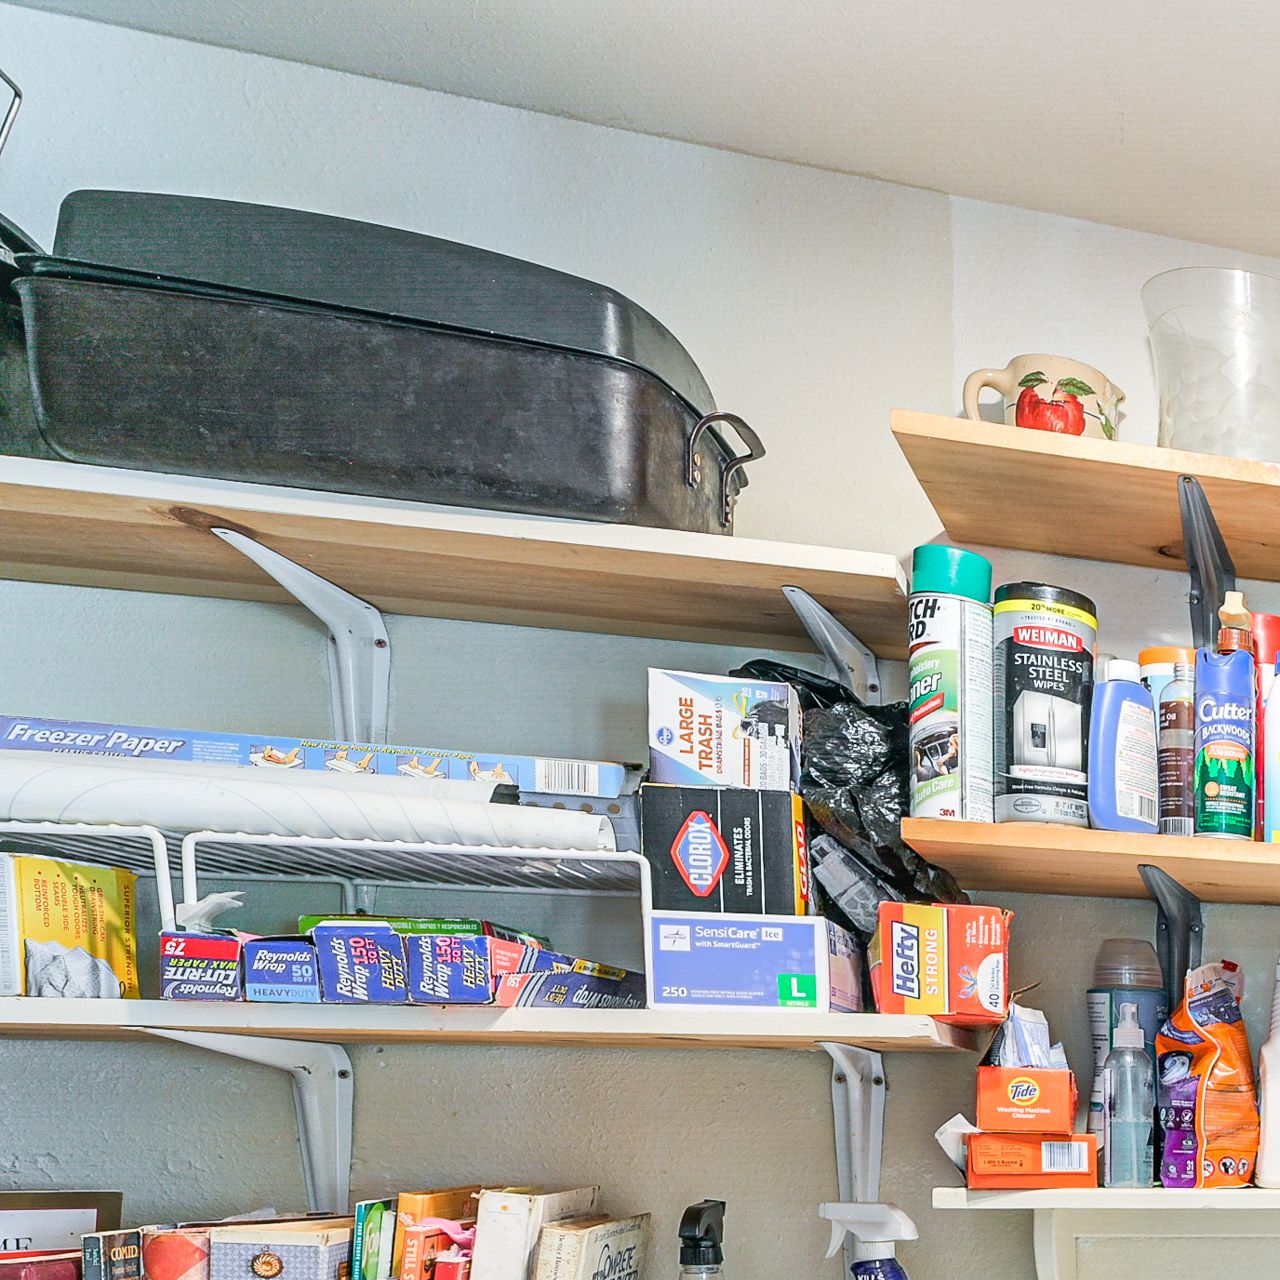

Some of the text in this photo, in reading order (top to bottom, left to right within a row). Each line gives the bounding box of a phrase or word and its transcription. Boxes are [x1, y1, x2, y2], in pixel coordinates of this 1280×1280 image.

[1017, 628, 1077, 649] WEIMAN
[1014, 653, 1083, 673] STAINLESS
[1028, 667, 1070, 683] STEEL
[1033, 680, 1065, 691] WIPES
[678, 697, 695, 755] LARGE
[1200, 699, 1253, 722] Cutter
[7, 723, 108, 748] Freezer
[105, 731, 185, 758] Paper
[698, 713, 714, 771] TRASH
[1202, 723, 1251, 744] BACKWOODS
[939, 808, 955, 817] 3M
[687, 820, 713, 886] CLOROX
[732, 826, 745, 885] ELIMINATES
[795, 824, 808, 896] GLAD
[34, 878, 42, 912] BOTTOM
[41, 879, 50, 928] REINFORCED
[61, 881, 69, 913] DOUBLE
[78, 884, 88, 934] NEUTRALIZES
[90, 886, 99, 935] DRAWSTRING
[72, 885, 82, 939] TOUGH ODORS
[694, 925, 780, 939] SensiCare Ice
[695, 940, 757, 950] with SmartGuard
[164, 941, 186, 956] 75
[168, 957, 238, 970] WAX PAPER
[255, 948, 312, 963] Reynolds
[348, 936, 369, 966] 150
[435, 936, 452, 963] 150
[895, 926, 919, 994] Hefty
[924, 927, 939, 997] STRONG
[163, 967, 238, 985] CUT-RITE
[252, 959, 286, 974] Wrap
[291, 964, 313, 977] 50
[336, 937, 352, 998] Reynolds
[378, 947, 396, 991] HEAVY
[393, 956, 406, 989] DUTY
[419, 936, 433, 995] Reynolds
[462, 944, 477, 989] HEAVY
[475, 956, 488, 988] DUTY
[178, 982, 238, 998] Reynolds
[350, 966, 369, 1001] Wrap
[433, 964, 450, 999] Wrap
[662, 986, 688, 997] 250
[790, 976, 807, 998] L
[989, 993, 1000, 1009] 40
[1011, 1083, 1037, 1100] Tide
[997, 1106, 1025, 1114] Washing
[404, 1238, 418, 1270] STILL
